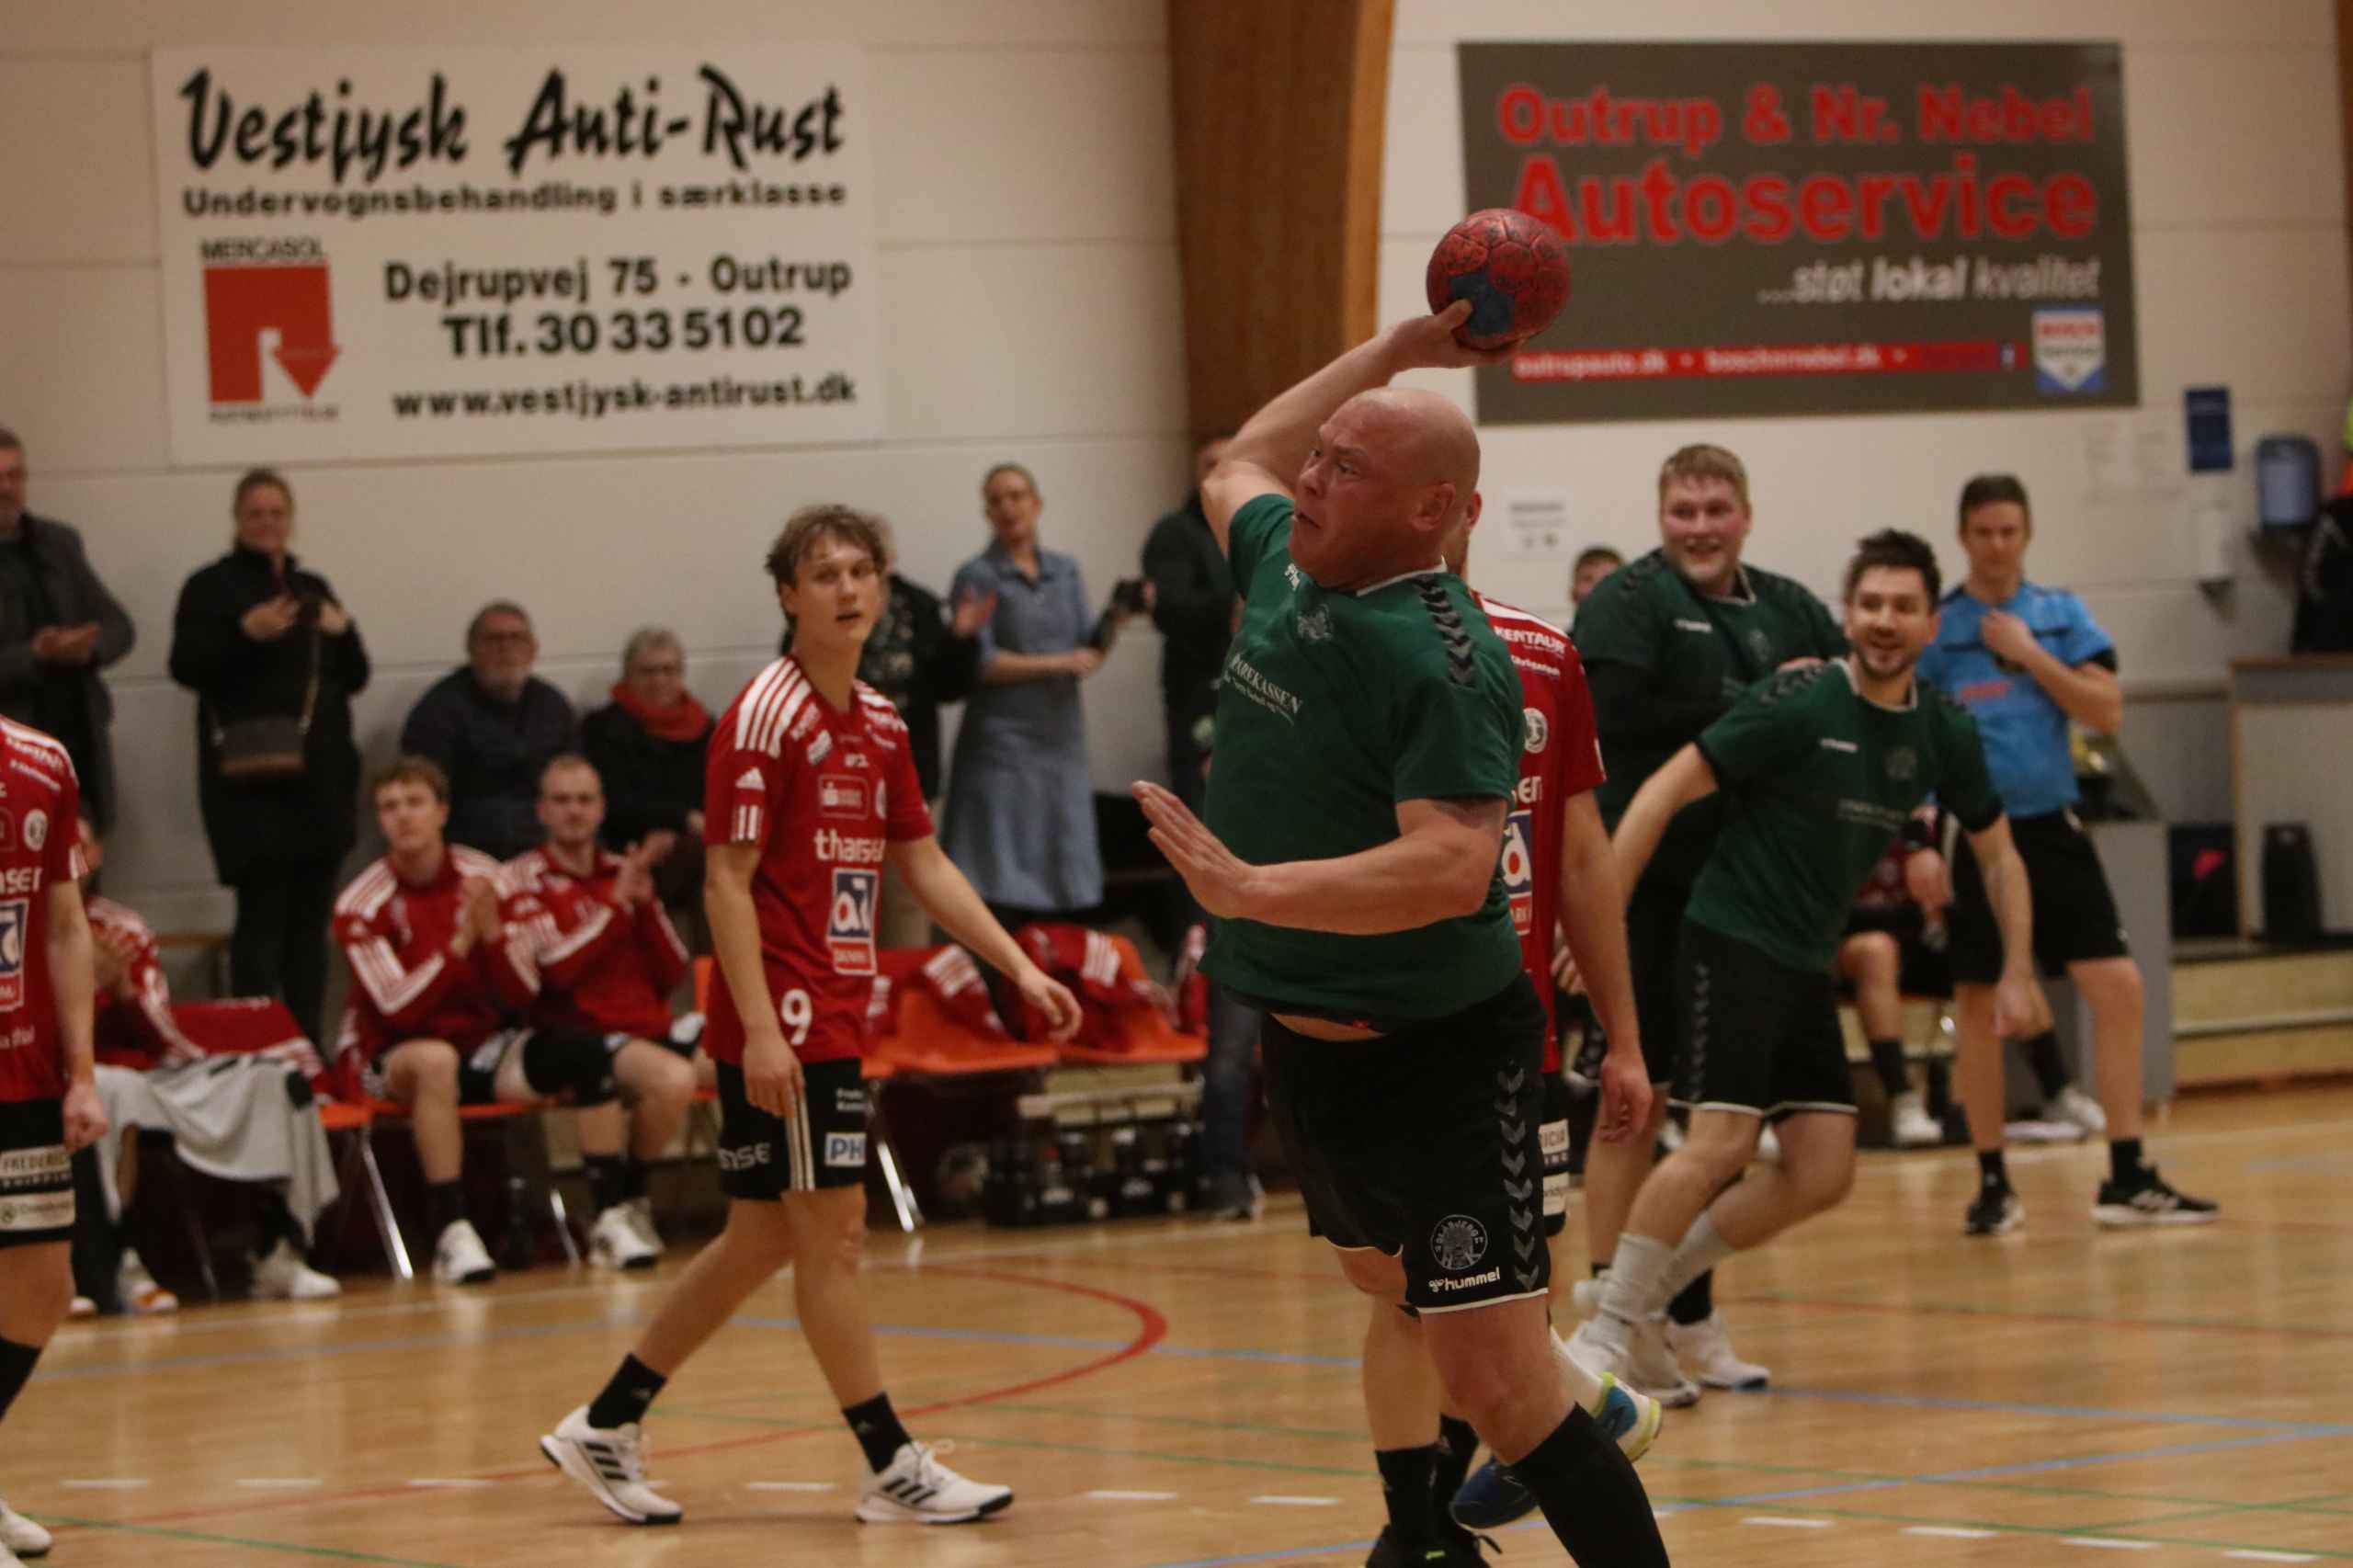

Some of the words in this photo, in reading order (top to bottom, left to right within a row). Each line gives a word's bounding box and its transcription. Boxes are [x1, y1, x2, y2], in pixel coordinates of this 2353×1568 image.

[180, 67, 470, 185] Vestjysk
[504, 63, 844, 177] Anti-Rust
[1497, 83, 1723, 158] Outrup
[1745, 85, 1790, 142] &
[1811, 85, 1900, 142] Nr.
[1917, 85, 2094, 142] Nebel
[183, 186, 616, 220] Undervognsbehandling
[1512, 153, 2097, 244] Autoservice
[384, 259, 589, 307] Dejrupvej
[609, 256, 659, 297] 75
[710, 252, 852, 298] Outrup
[1871, 254, 1970, 301] lokal
[392, 370, 857, 420] www.vestjysk-antirust.dk
[780, 987, 813, 1046] 9
[1444, 1266, 1501, 1292] hummel
